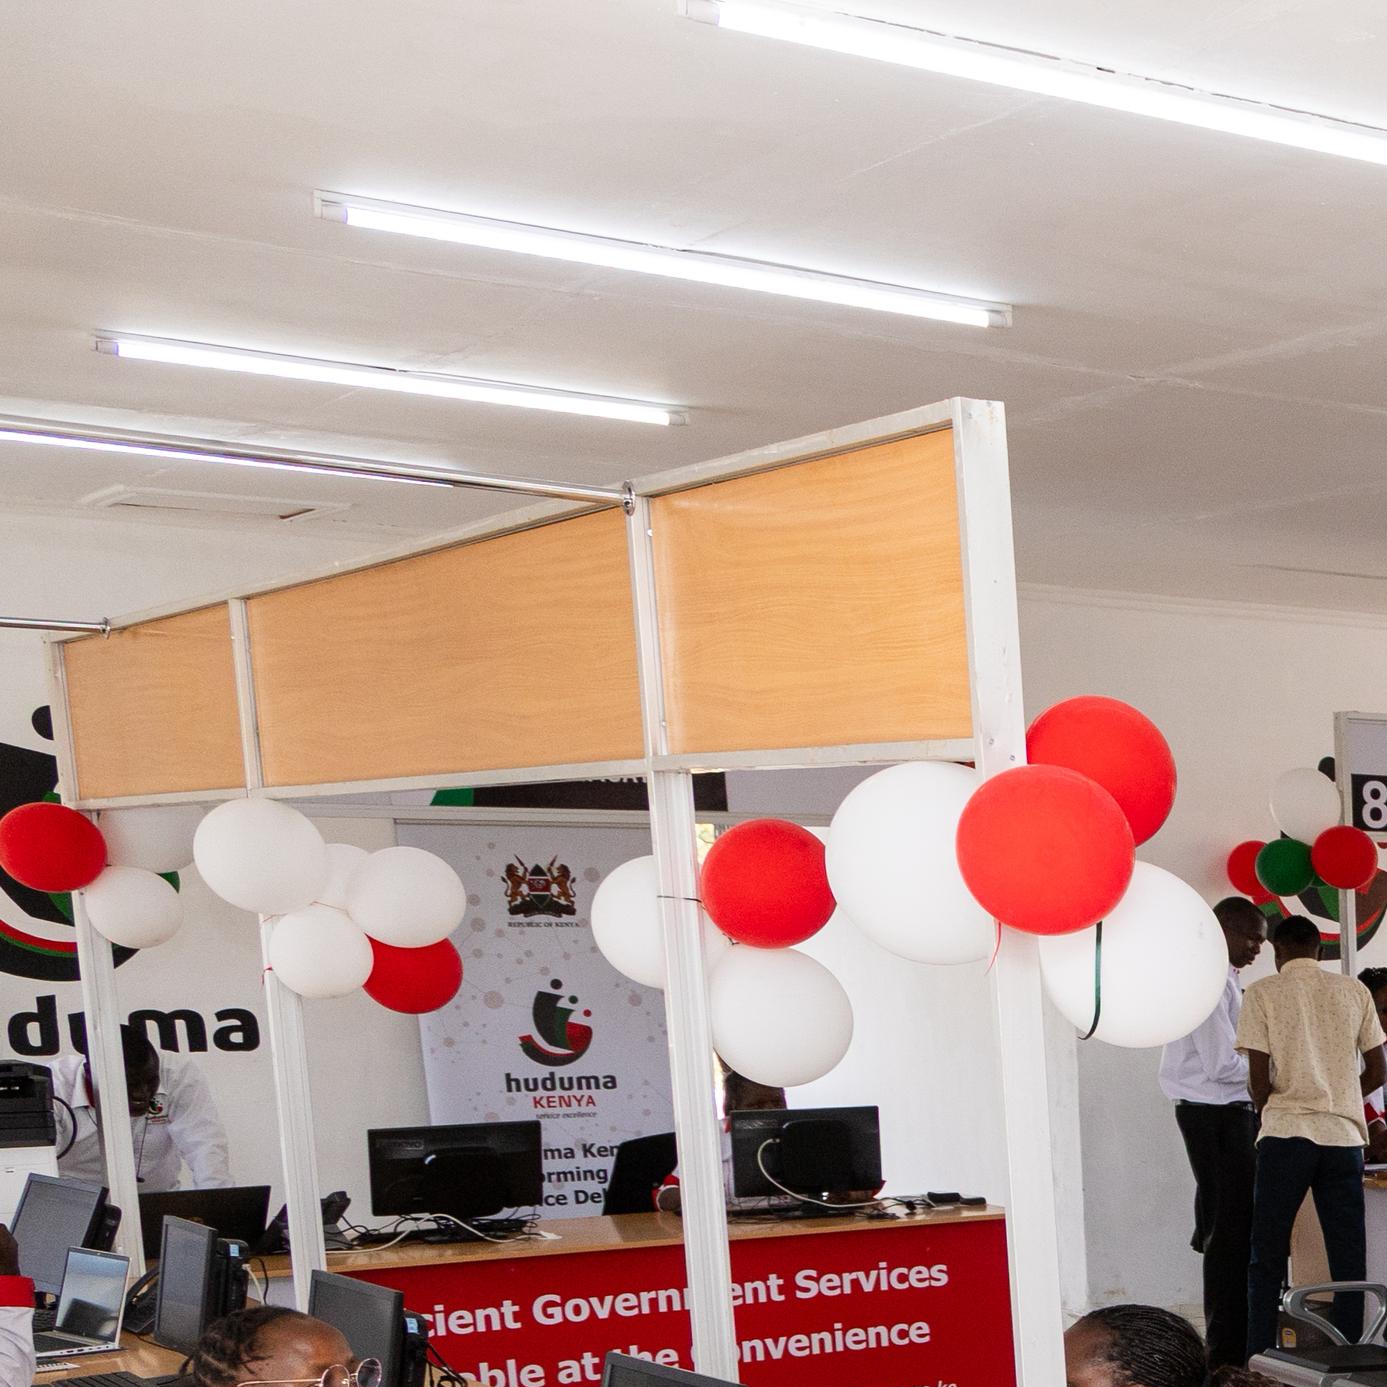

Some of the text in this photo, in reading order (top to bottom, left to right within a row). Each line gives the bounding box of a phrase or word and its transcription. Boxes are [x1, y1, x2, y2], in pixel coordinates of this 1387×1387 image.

[505, 1071, 617, 1092] huduma
[533, 1095, 596, 1109] KENYA
[532, 1272, 785, 1326] Governent
[795, 1262, 949, 1299] Services
[557, 1352, 601, 1385] at
